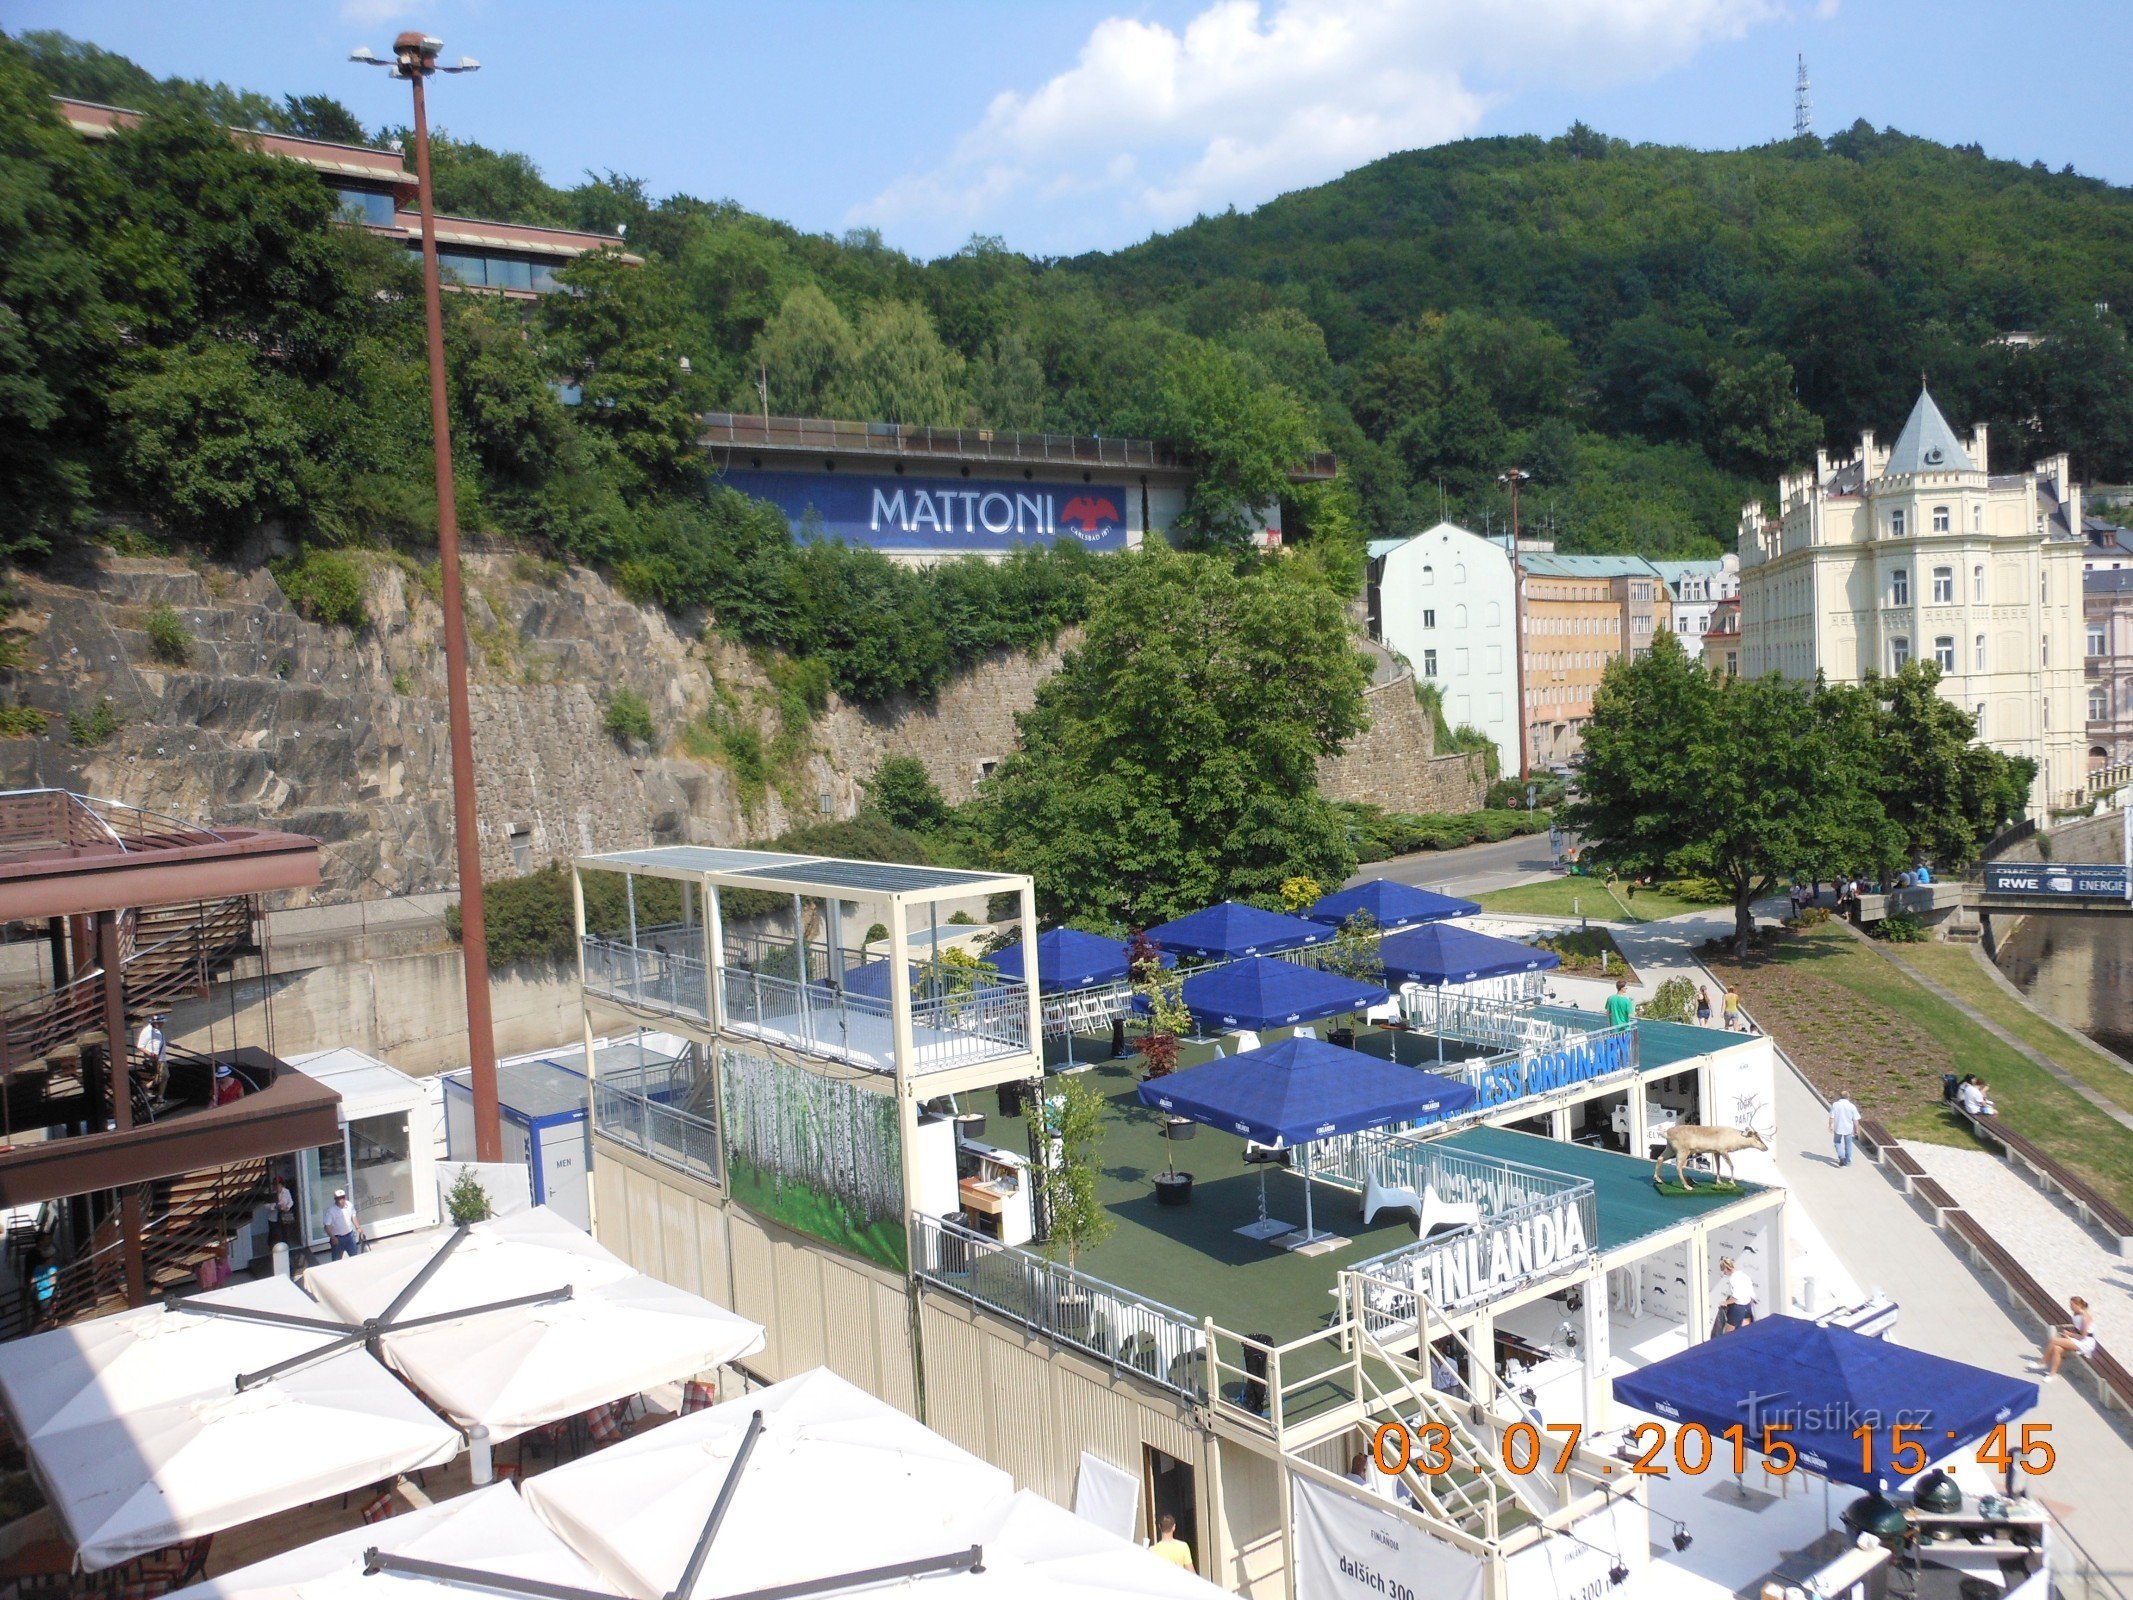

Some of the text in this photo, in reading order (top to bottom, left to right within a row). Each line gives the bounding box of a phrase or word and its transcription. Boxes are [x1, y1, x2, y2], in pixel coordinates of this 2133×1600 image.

[871, 488, 1056, 536] MATTONI
[1071, 526, 1101, 541] CARLSBAD
[1998, 878, 2126, 891] RWE ENERGIE
[1527, 1033, 1631, 1095] ORDINARY
[556, 1158, 572, 1168] MEN
[1413, 1201, 1587, 1306] FINLANDIA
[1371, 1530, 1400, 1551] FINLANDIA
[1340, 1555, 1415, 1600] dalších 300
